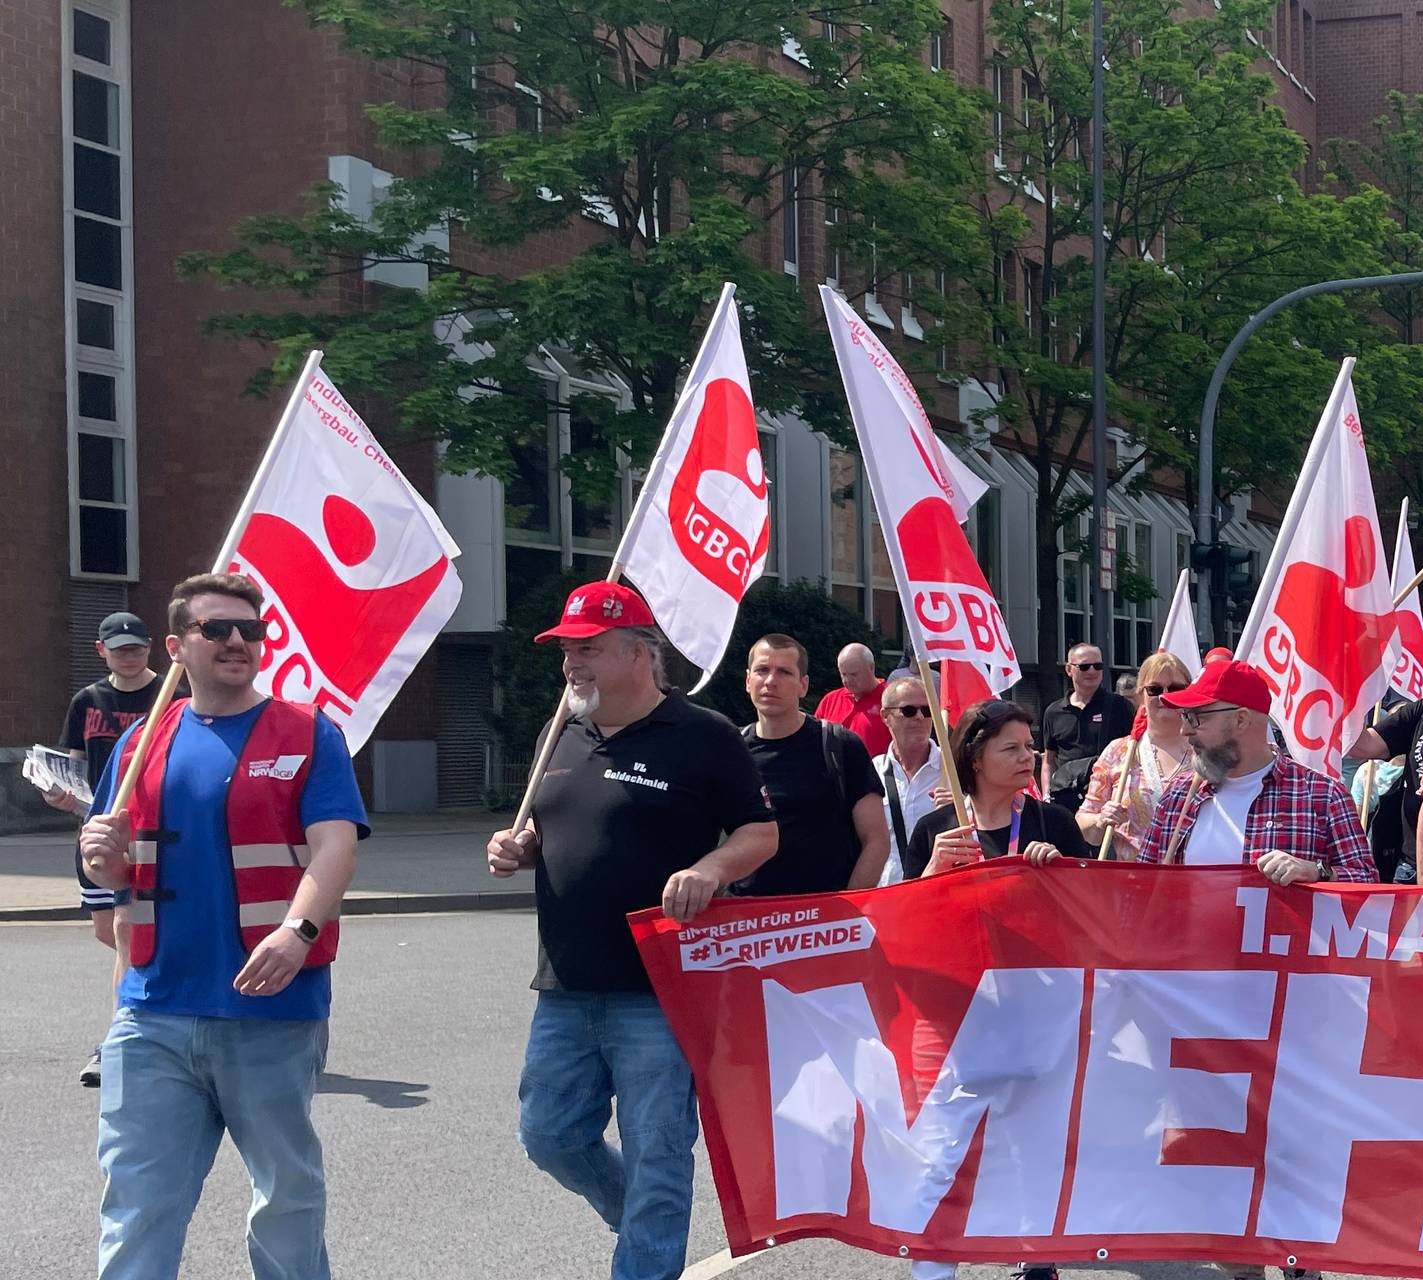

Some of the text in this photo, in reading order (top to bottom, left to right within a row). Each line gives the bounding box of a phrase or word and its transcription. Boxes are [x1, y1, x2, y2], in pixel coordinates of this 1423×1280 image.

[914, 591, 1014, 677] IGBC
[603, 769, 669, 791] Goldschmidt
[761, 911, 791, 928] FÜR
[794, 907, 820, 922] DIE
[1235, 887, 1291, 956] 1.
